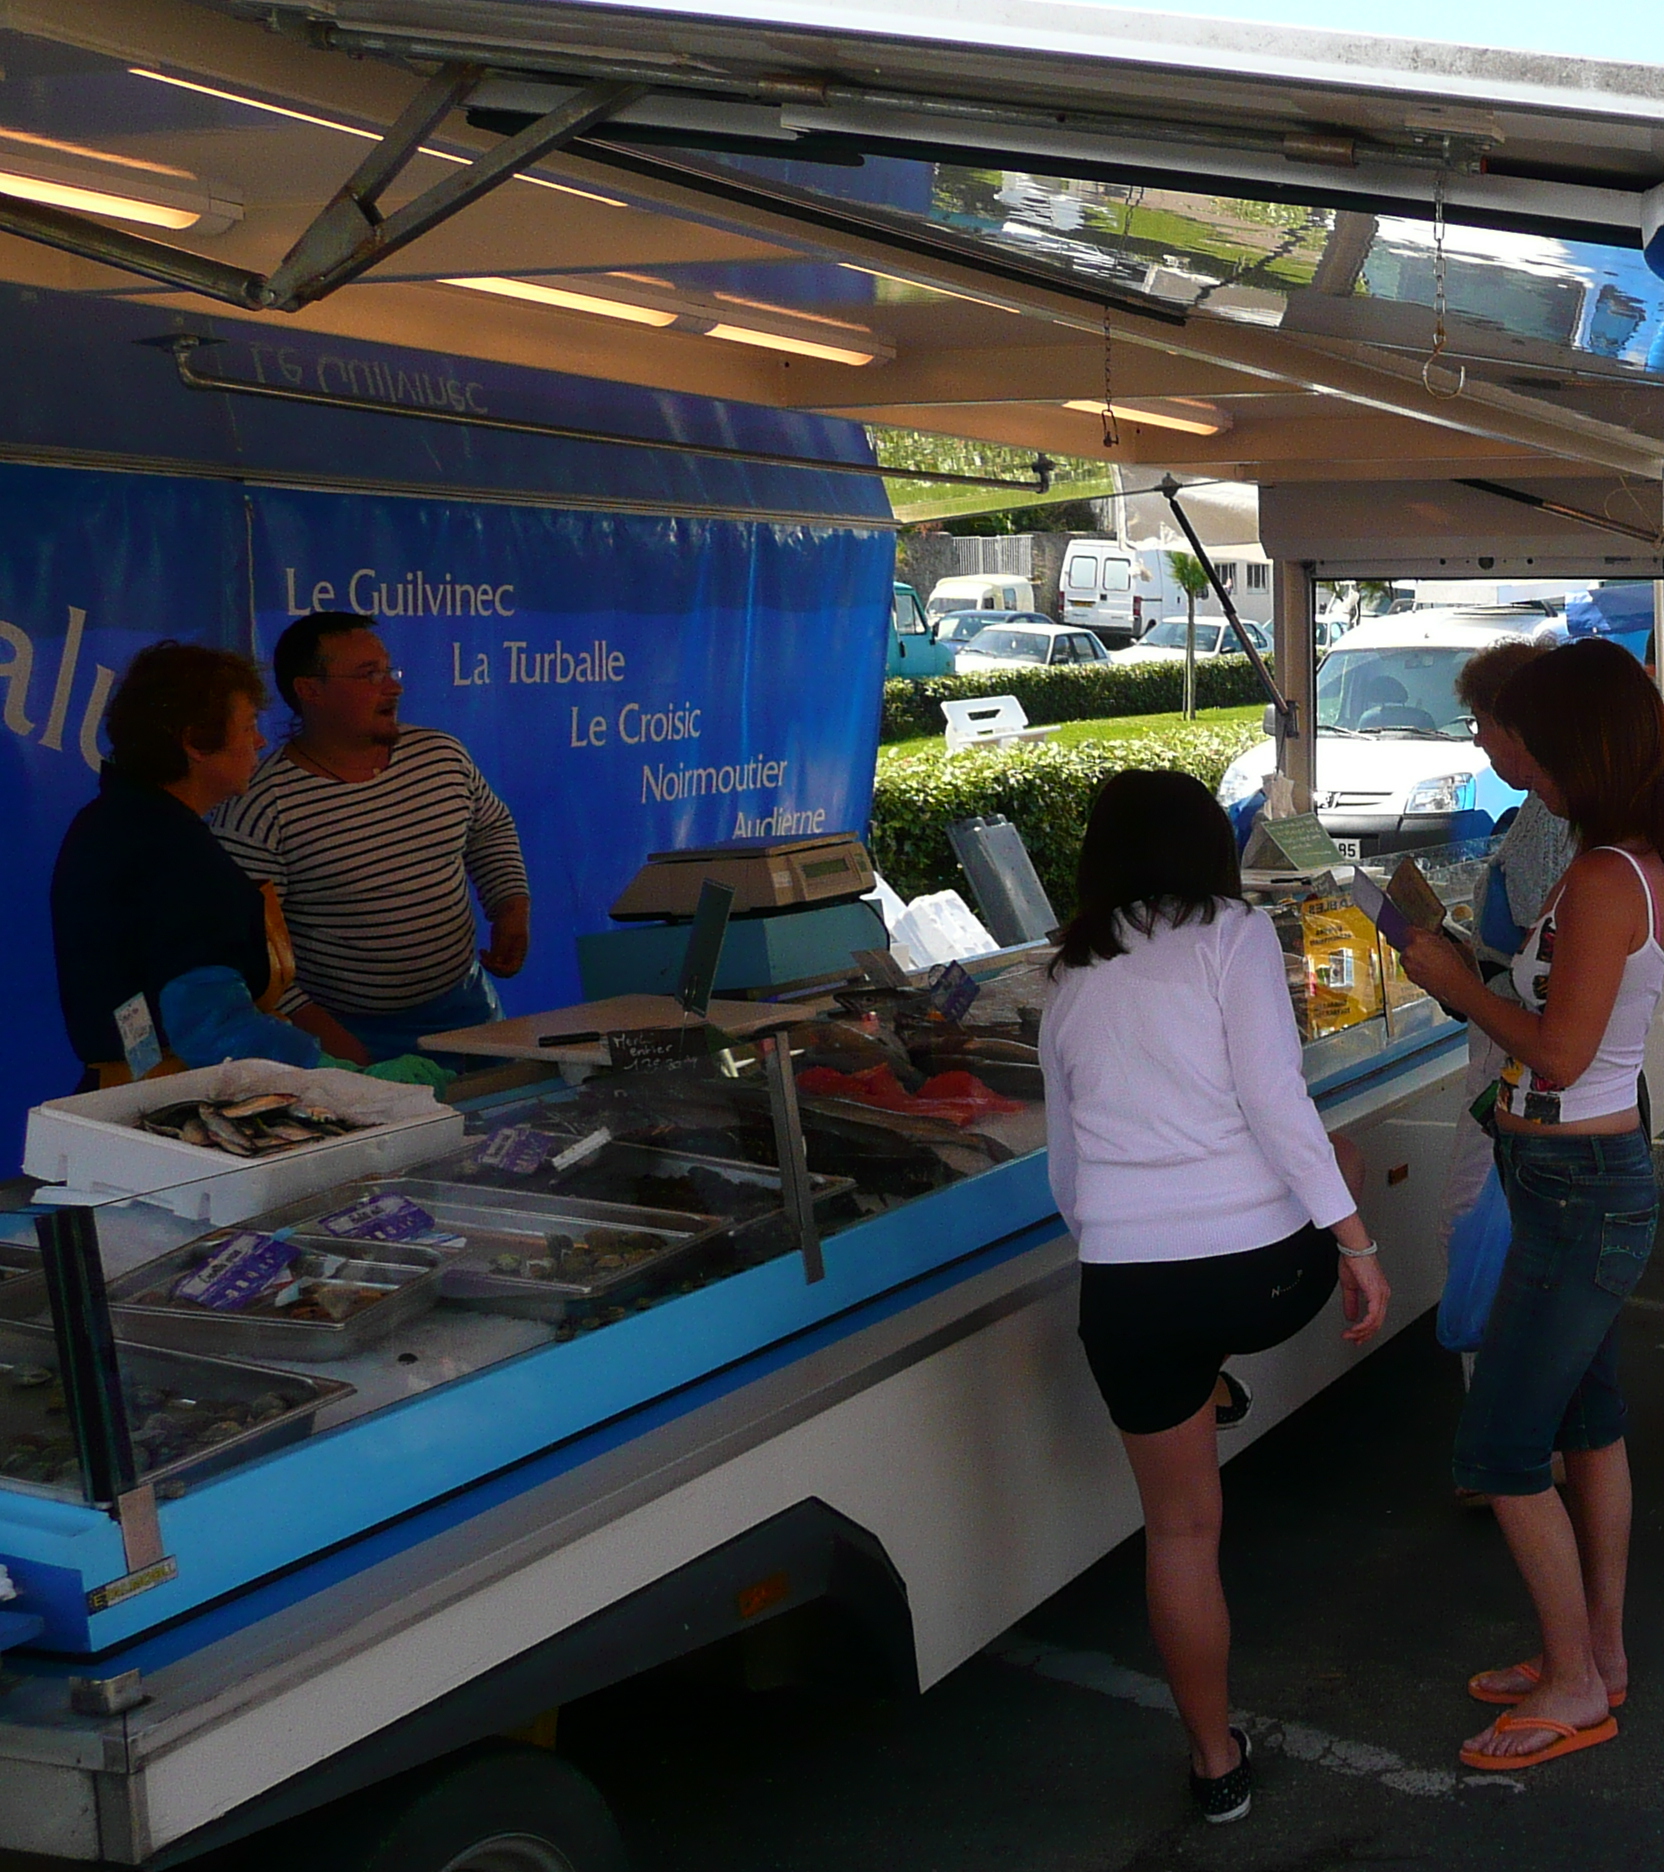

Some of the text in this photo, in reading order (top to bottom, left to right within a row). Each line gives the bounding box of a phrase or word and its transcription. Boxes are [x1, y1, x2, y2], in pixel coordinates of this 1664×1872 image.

[286, 568, 516, 616] Le Guilvinec
[453, 640, 626, 686] La Turballe
[570, 702, 701, 747] Le Croisic
[641, 754, 788, 804] Noirmoutier
